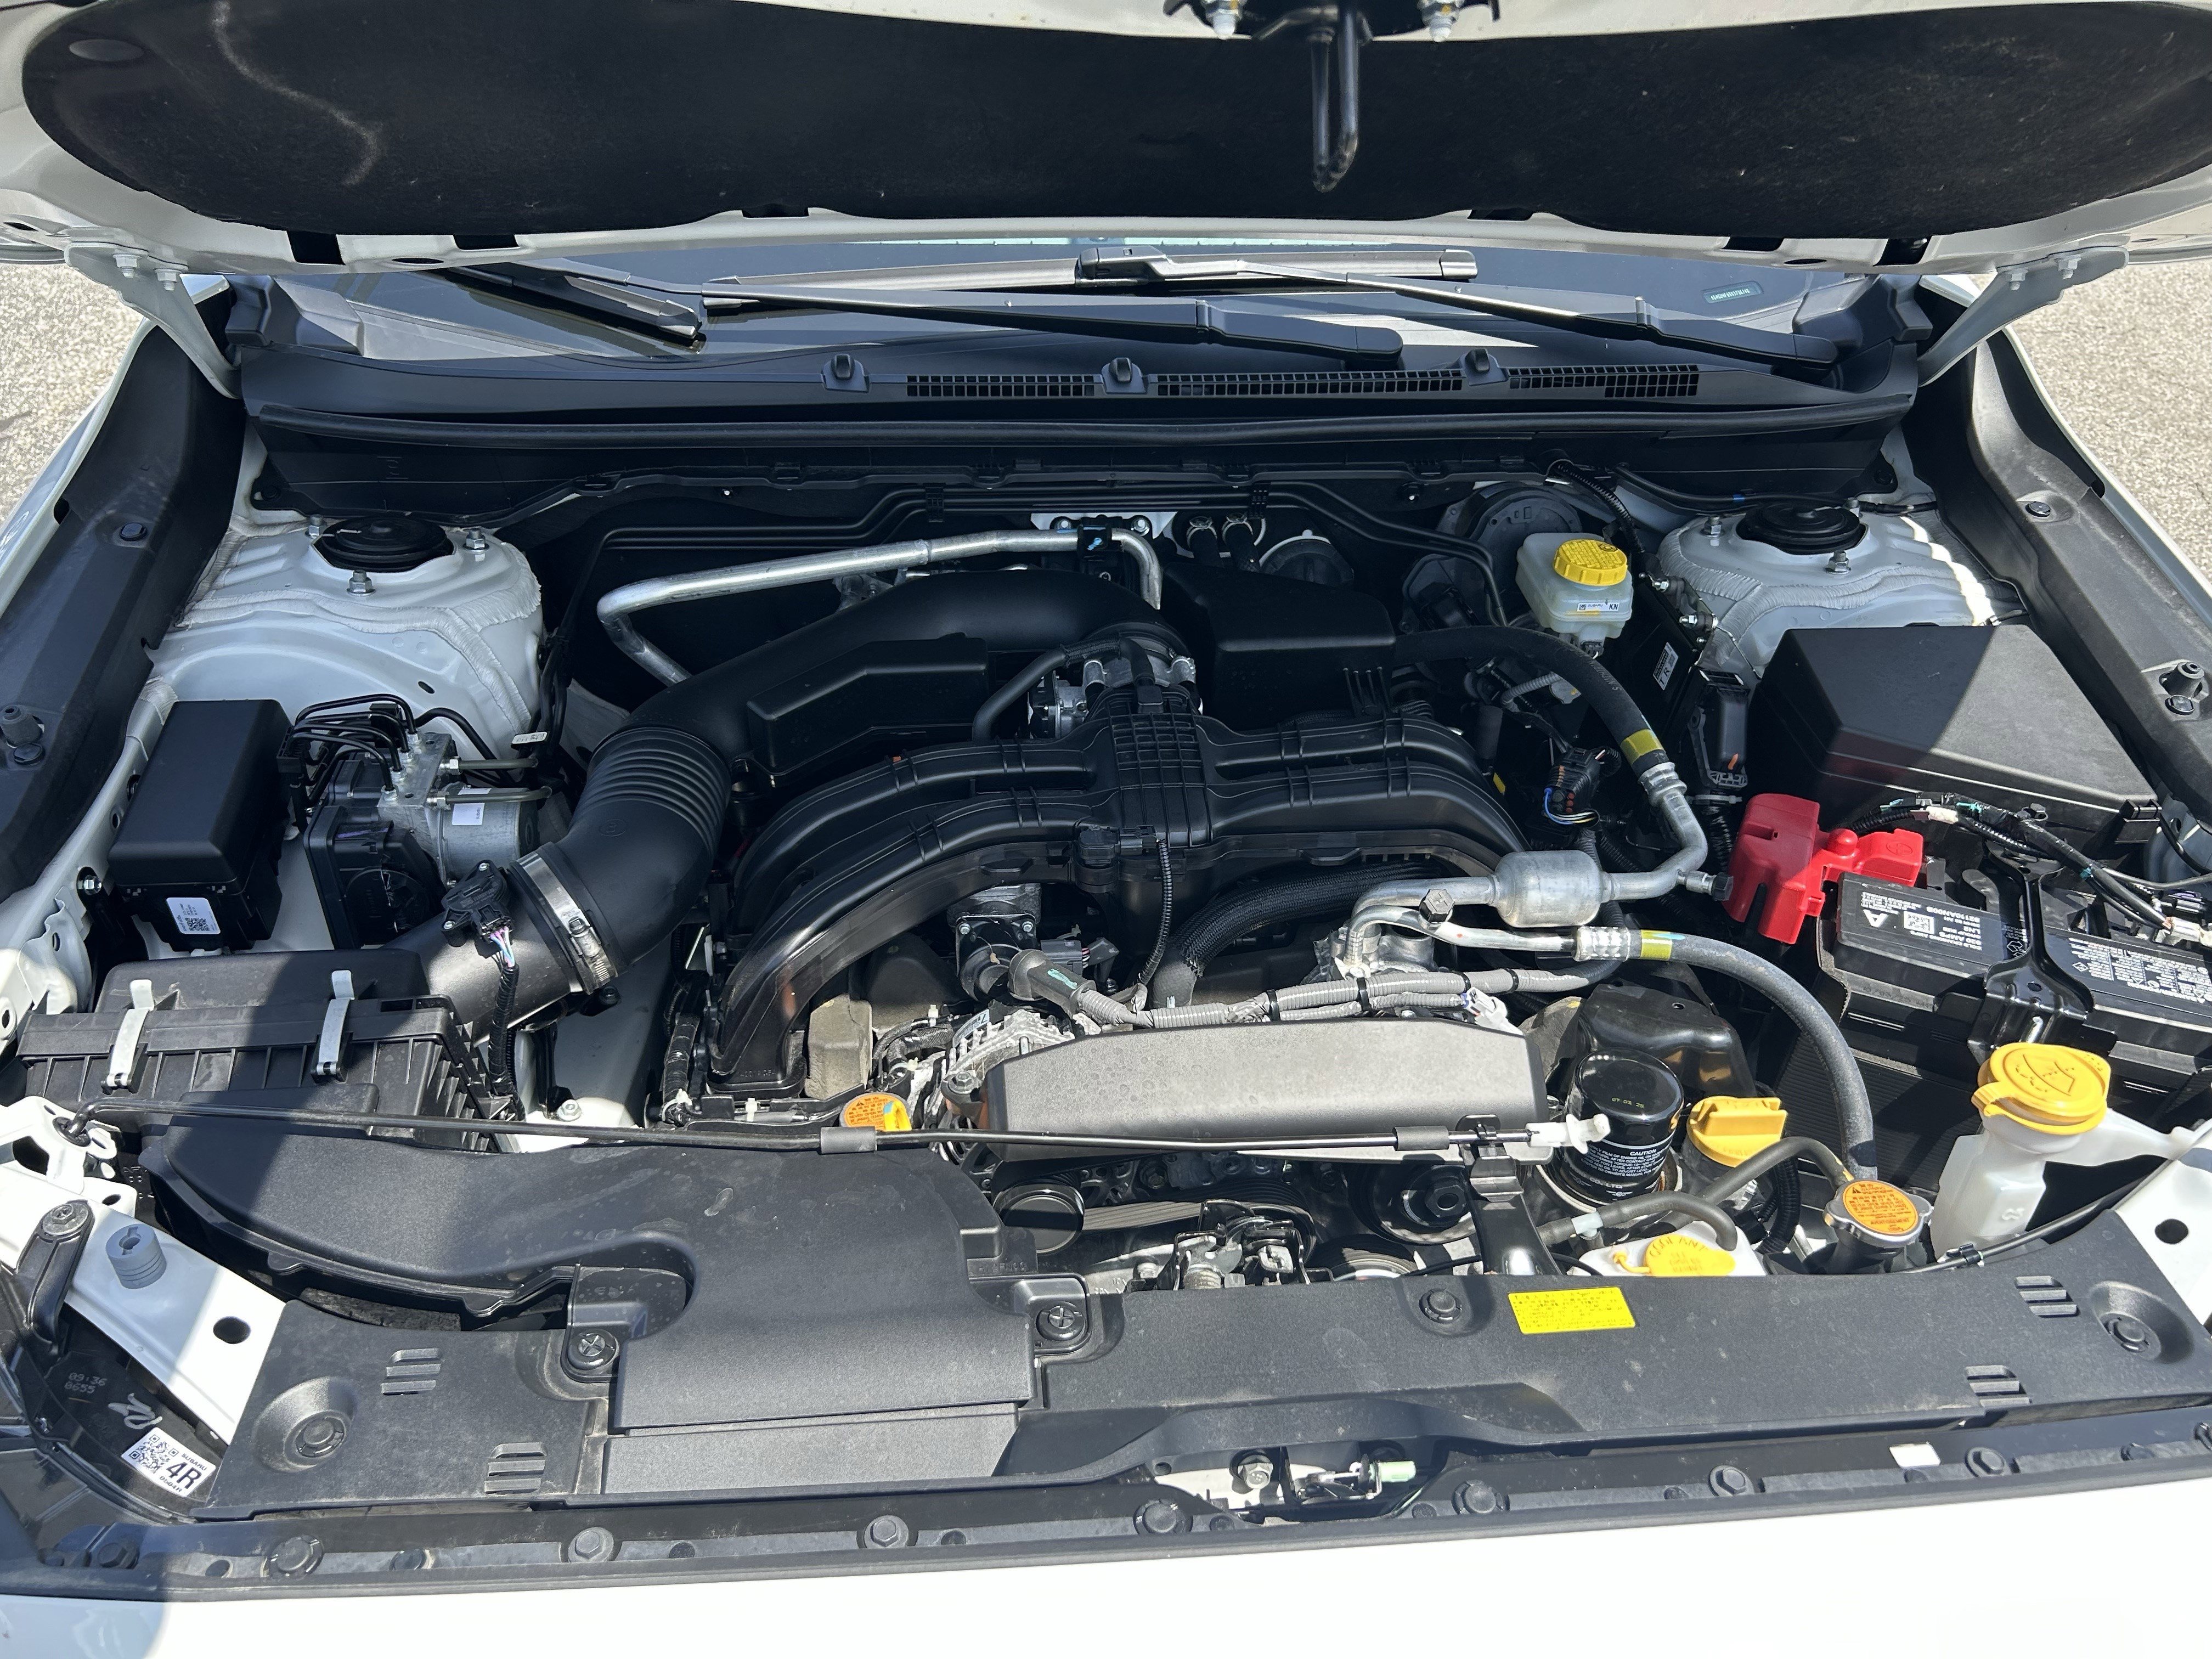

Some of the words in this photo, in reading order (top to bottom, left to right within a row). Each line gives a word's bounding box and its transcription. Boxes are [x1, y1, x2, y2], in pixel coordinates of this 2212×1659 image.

[1939, 931, 1965, 942] AMPS
[181, 1453, 208, 1471] SUBARU
[166, 1462, 202, 1489] 4R
